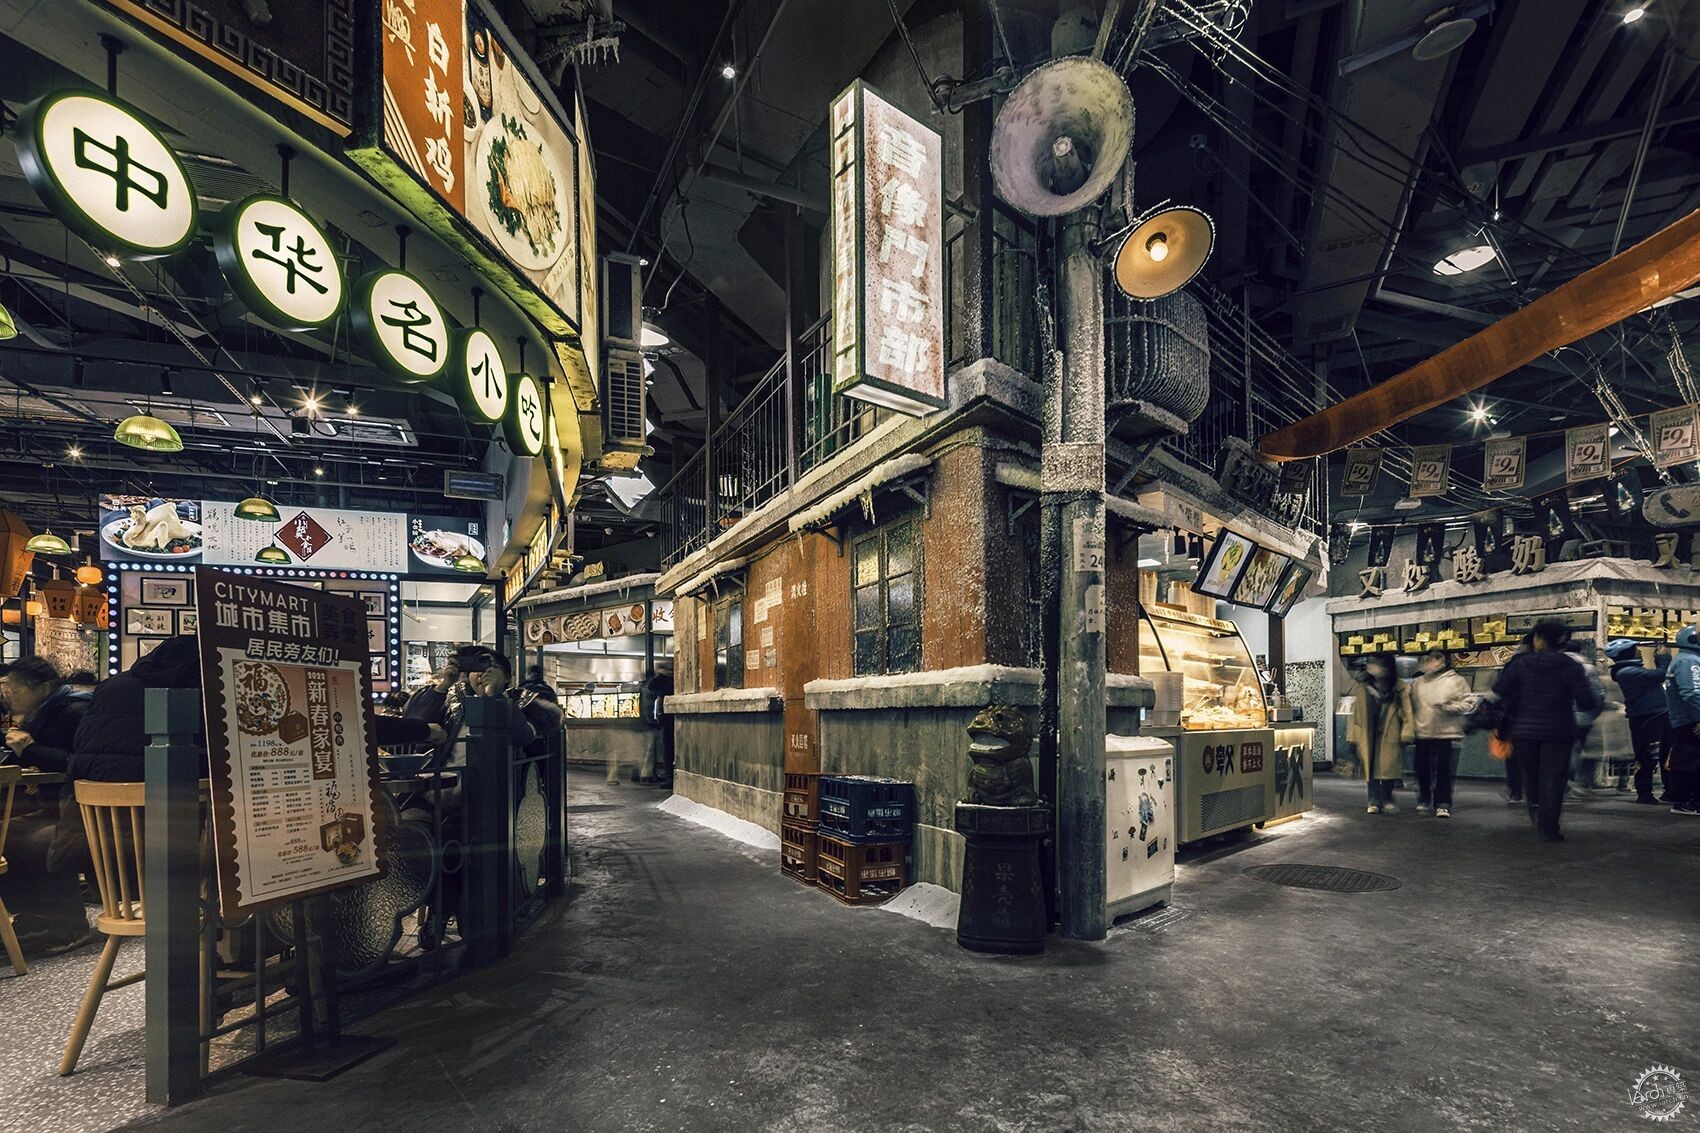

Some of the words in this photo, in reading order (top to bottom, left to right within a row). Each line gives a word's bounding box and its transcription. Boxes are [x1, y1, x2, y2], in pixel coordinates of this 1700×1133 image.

[1359, 536, 1546, 598] 又炒酸奶
[214, 582, 309, 613] CITYMART
[214, 600, 311, 638] 城市集市
[307, 671, 327, 680] 2022
[307, 681, 333, 774] 新春家宴
